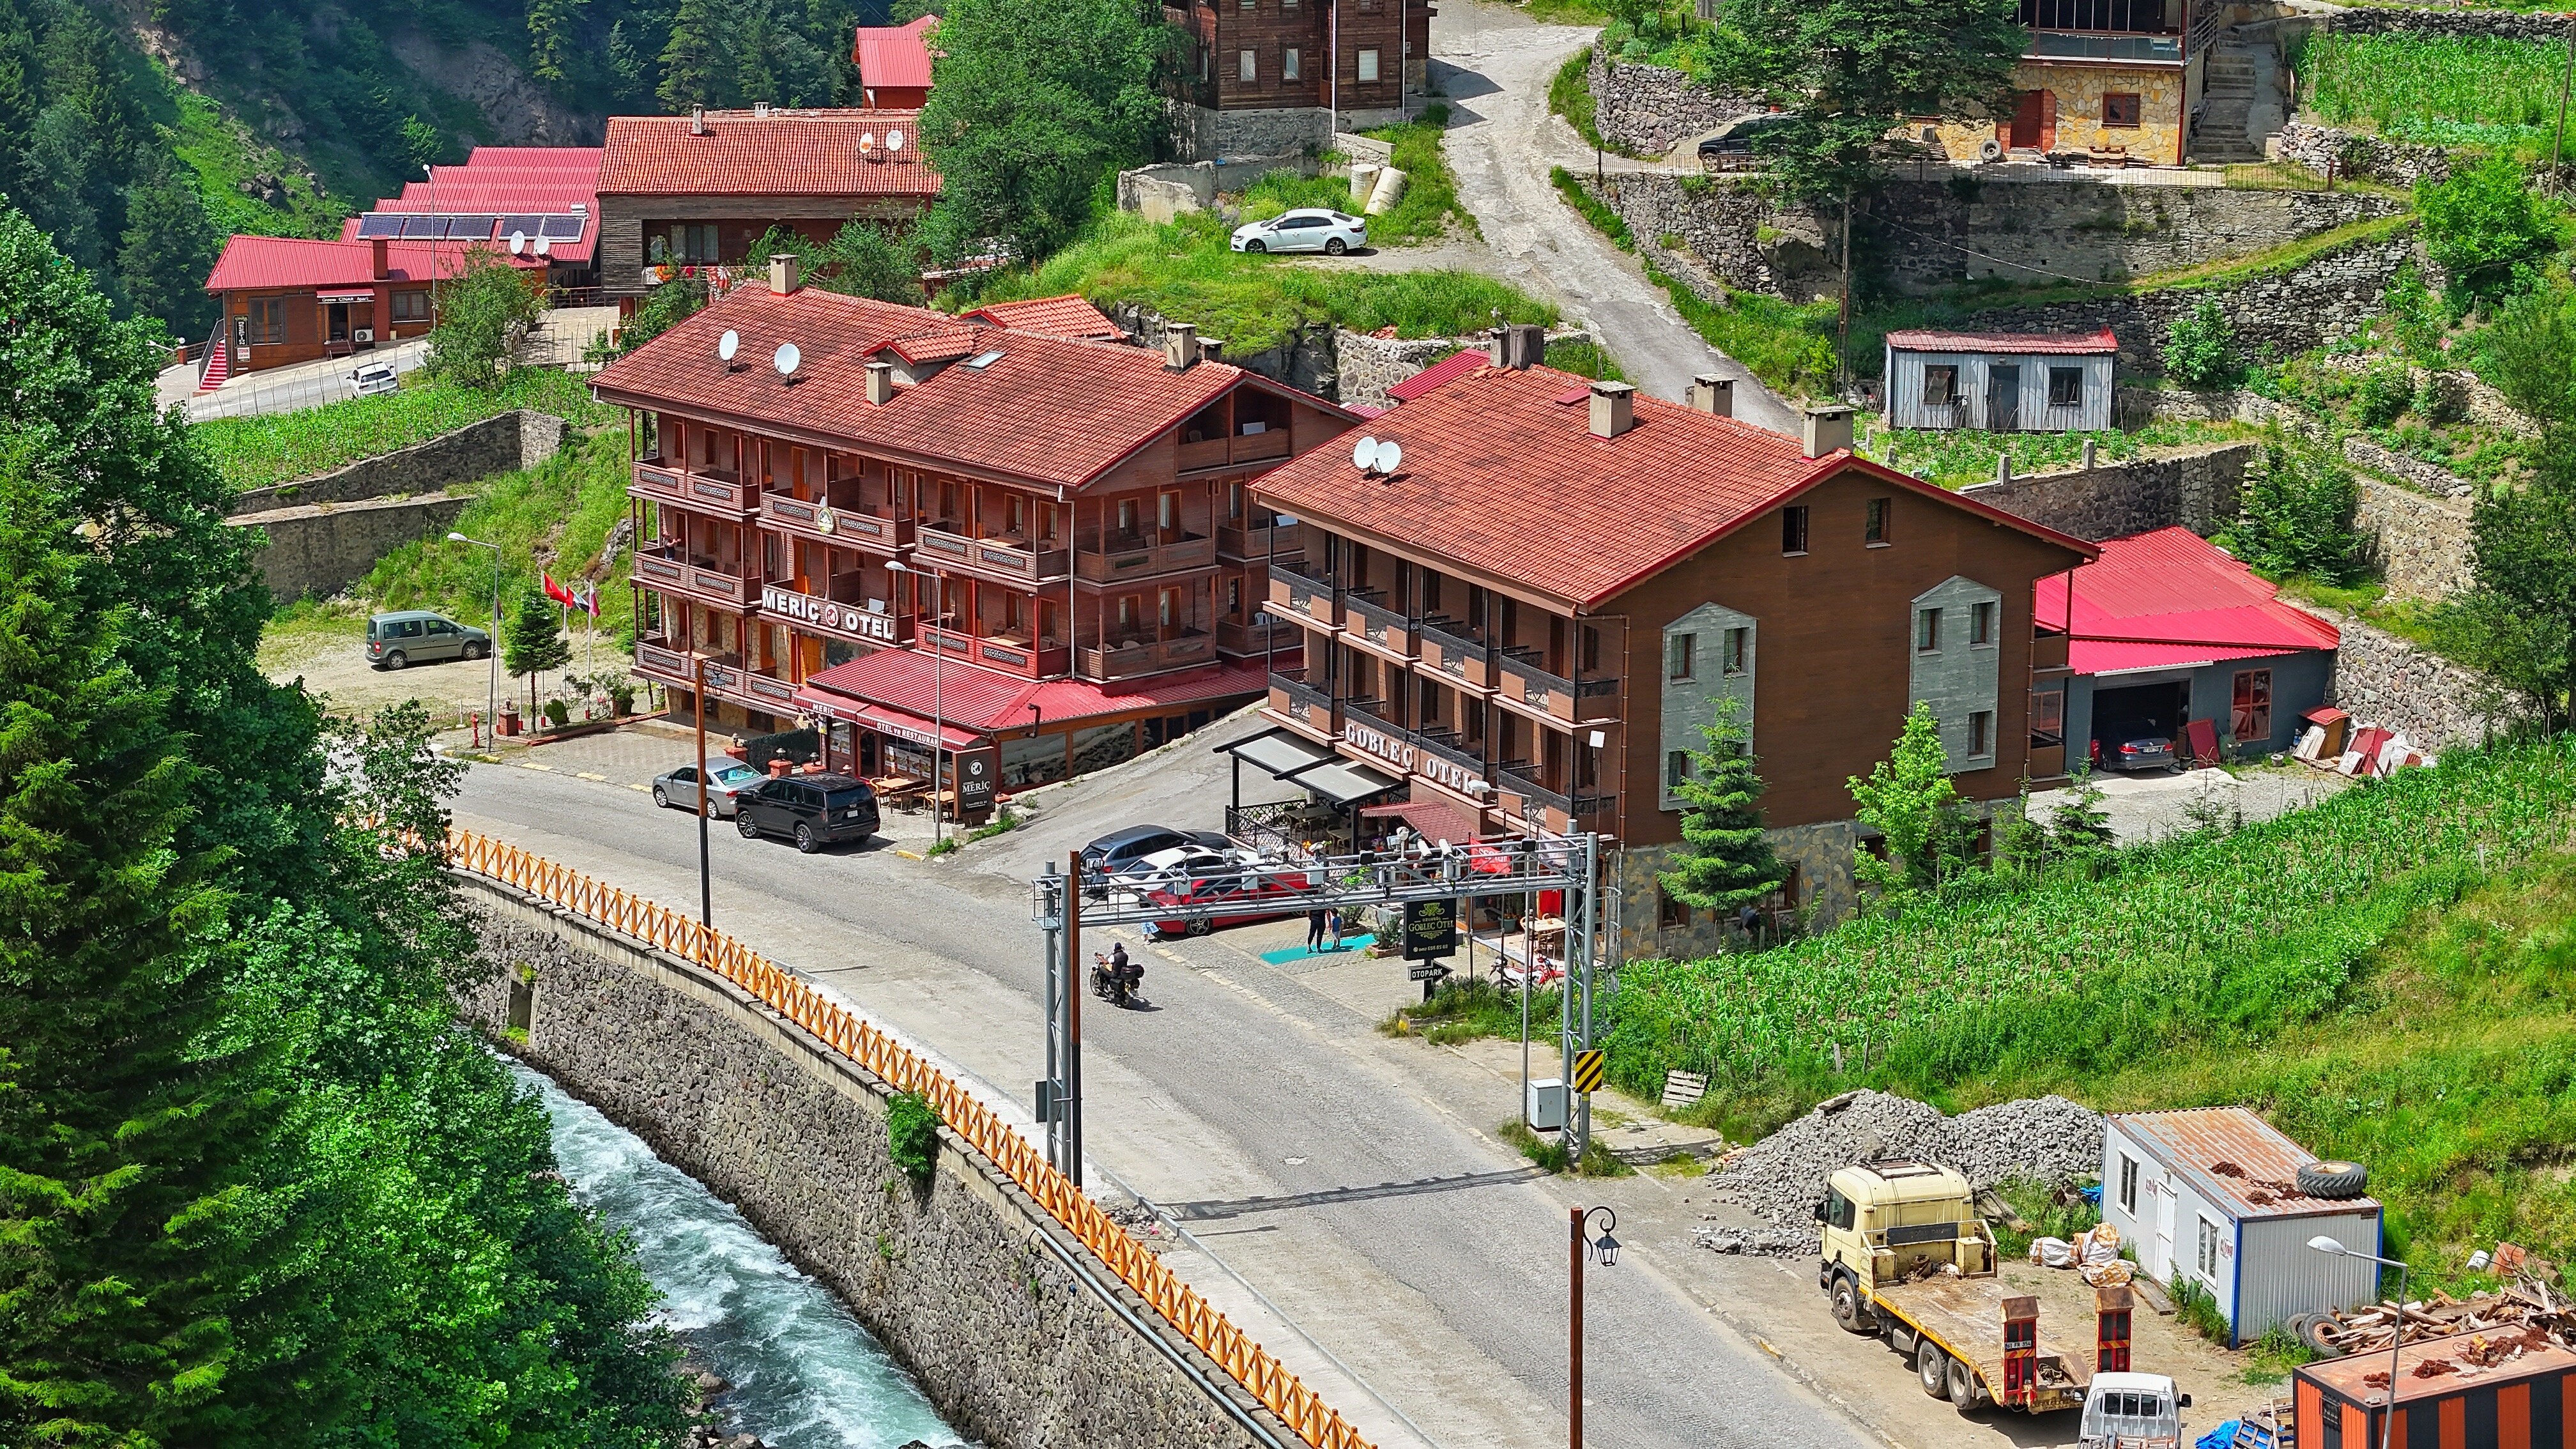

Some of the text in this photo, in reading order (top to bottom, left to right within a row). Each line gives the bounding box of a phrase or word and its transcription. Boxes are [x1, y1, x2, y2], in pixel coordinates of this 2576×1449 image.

[762, 589, 895, 640] MERİÇ OTEL
[877, 722, 893, 733] OTEL
[1426, 758, 1473, 795] OTEL
[962, 780, 991, 793] MERİÇ
[1436, 920, 1454, 929] OTEL
[1412, 969, 1443, 978] OTOPARK
